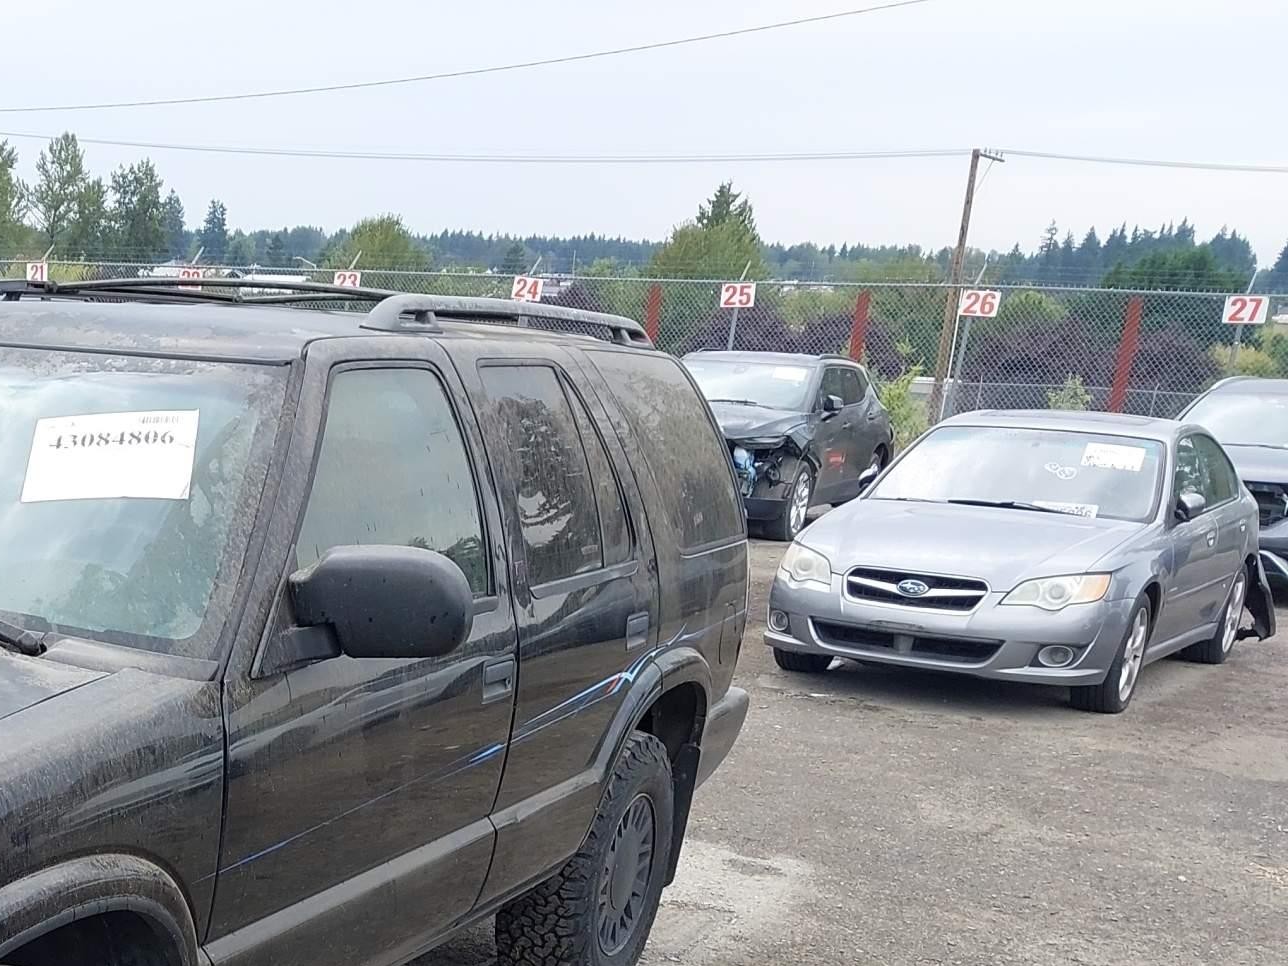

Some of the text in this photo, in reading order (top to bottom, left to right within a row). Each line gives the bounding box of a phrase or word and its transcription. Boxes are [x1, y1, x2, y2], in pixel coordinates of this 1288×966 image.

[30, 265, 45, 281] 21
[514, 278, 540, 299] 24
[723, 284, 752, 306] 25
[963, 292, 995, 314] 26
[1227, 298, 1263, 322] 27
[48, 429, 175, 450] 43084806
